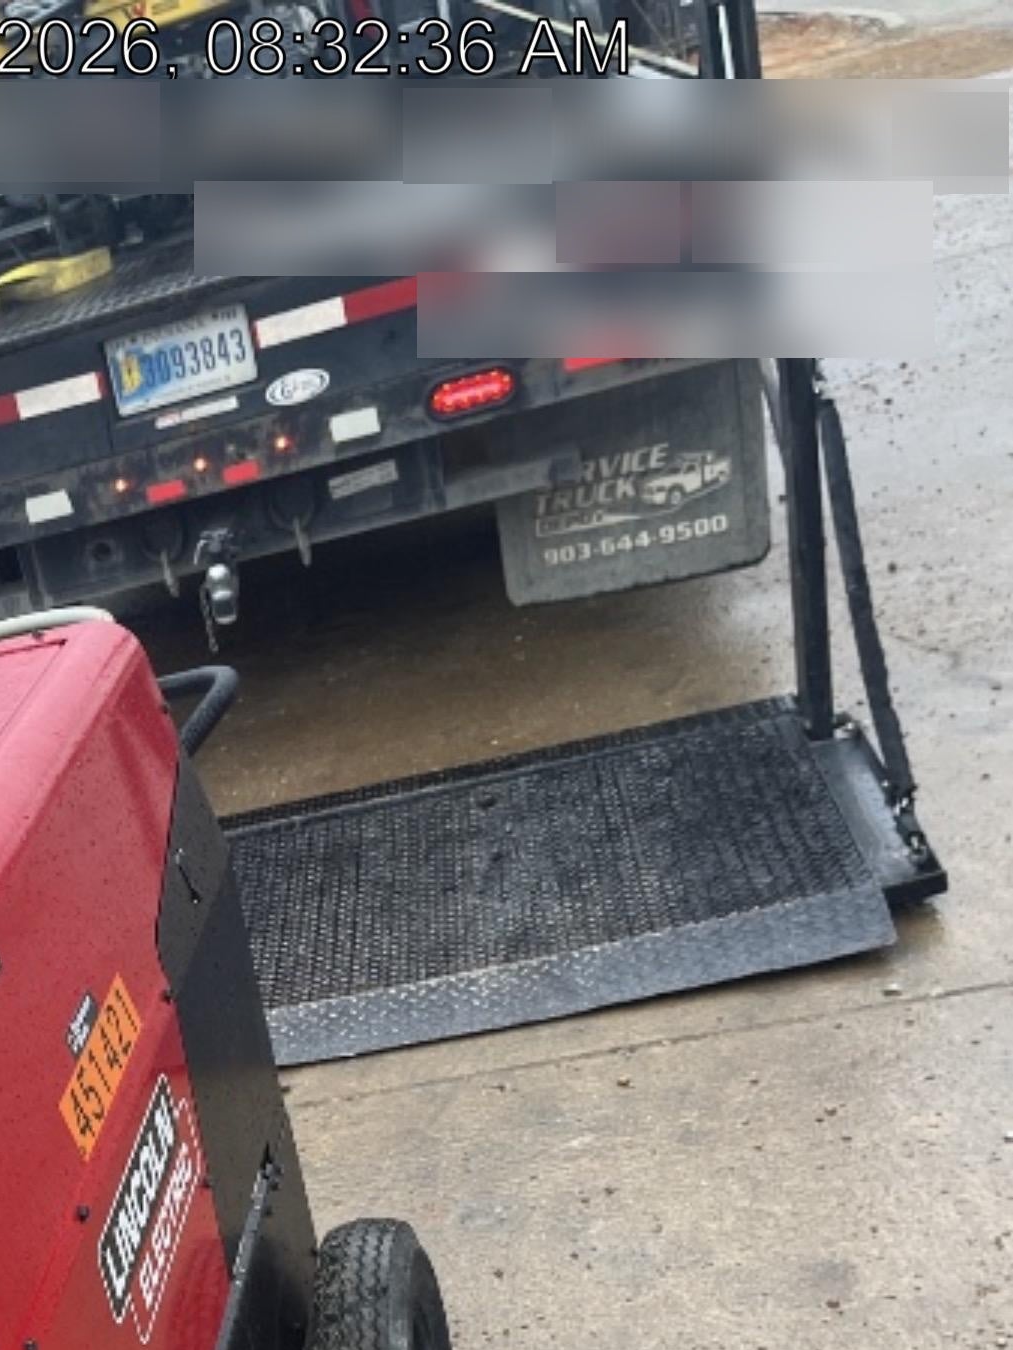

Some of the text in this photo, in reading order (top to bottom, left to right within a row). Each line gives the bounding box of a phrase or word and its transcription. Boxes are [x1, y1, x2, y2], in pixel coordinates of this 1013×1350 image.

[543, 514, 729, 566] 903-644-9500
[70, 989, 138, 1138] 451421
[105, 1094, 176, 1300] LINCOLN
[139, 1140, 193, 1311] ELECTRIC
